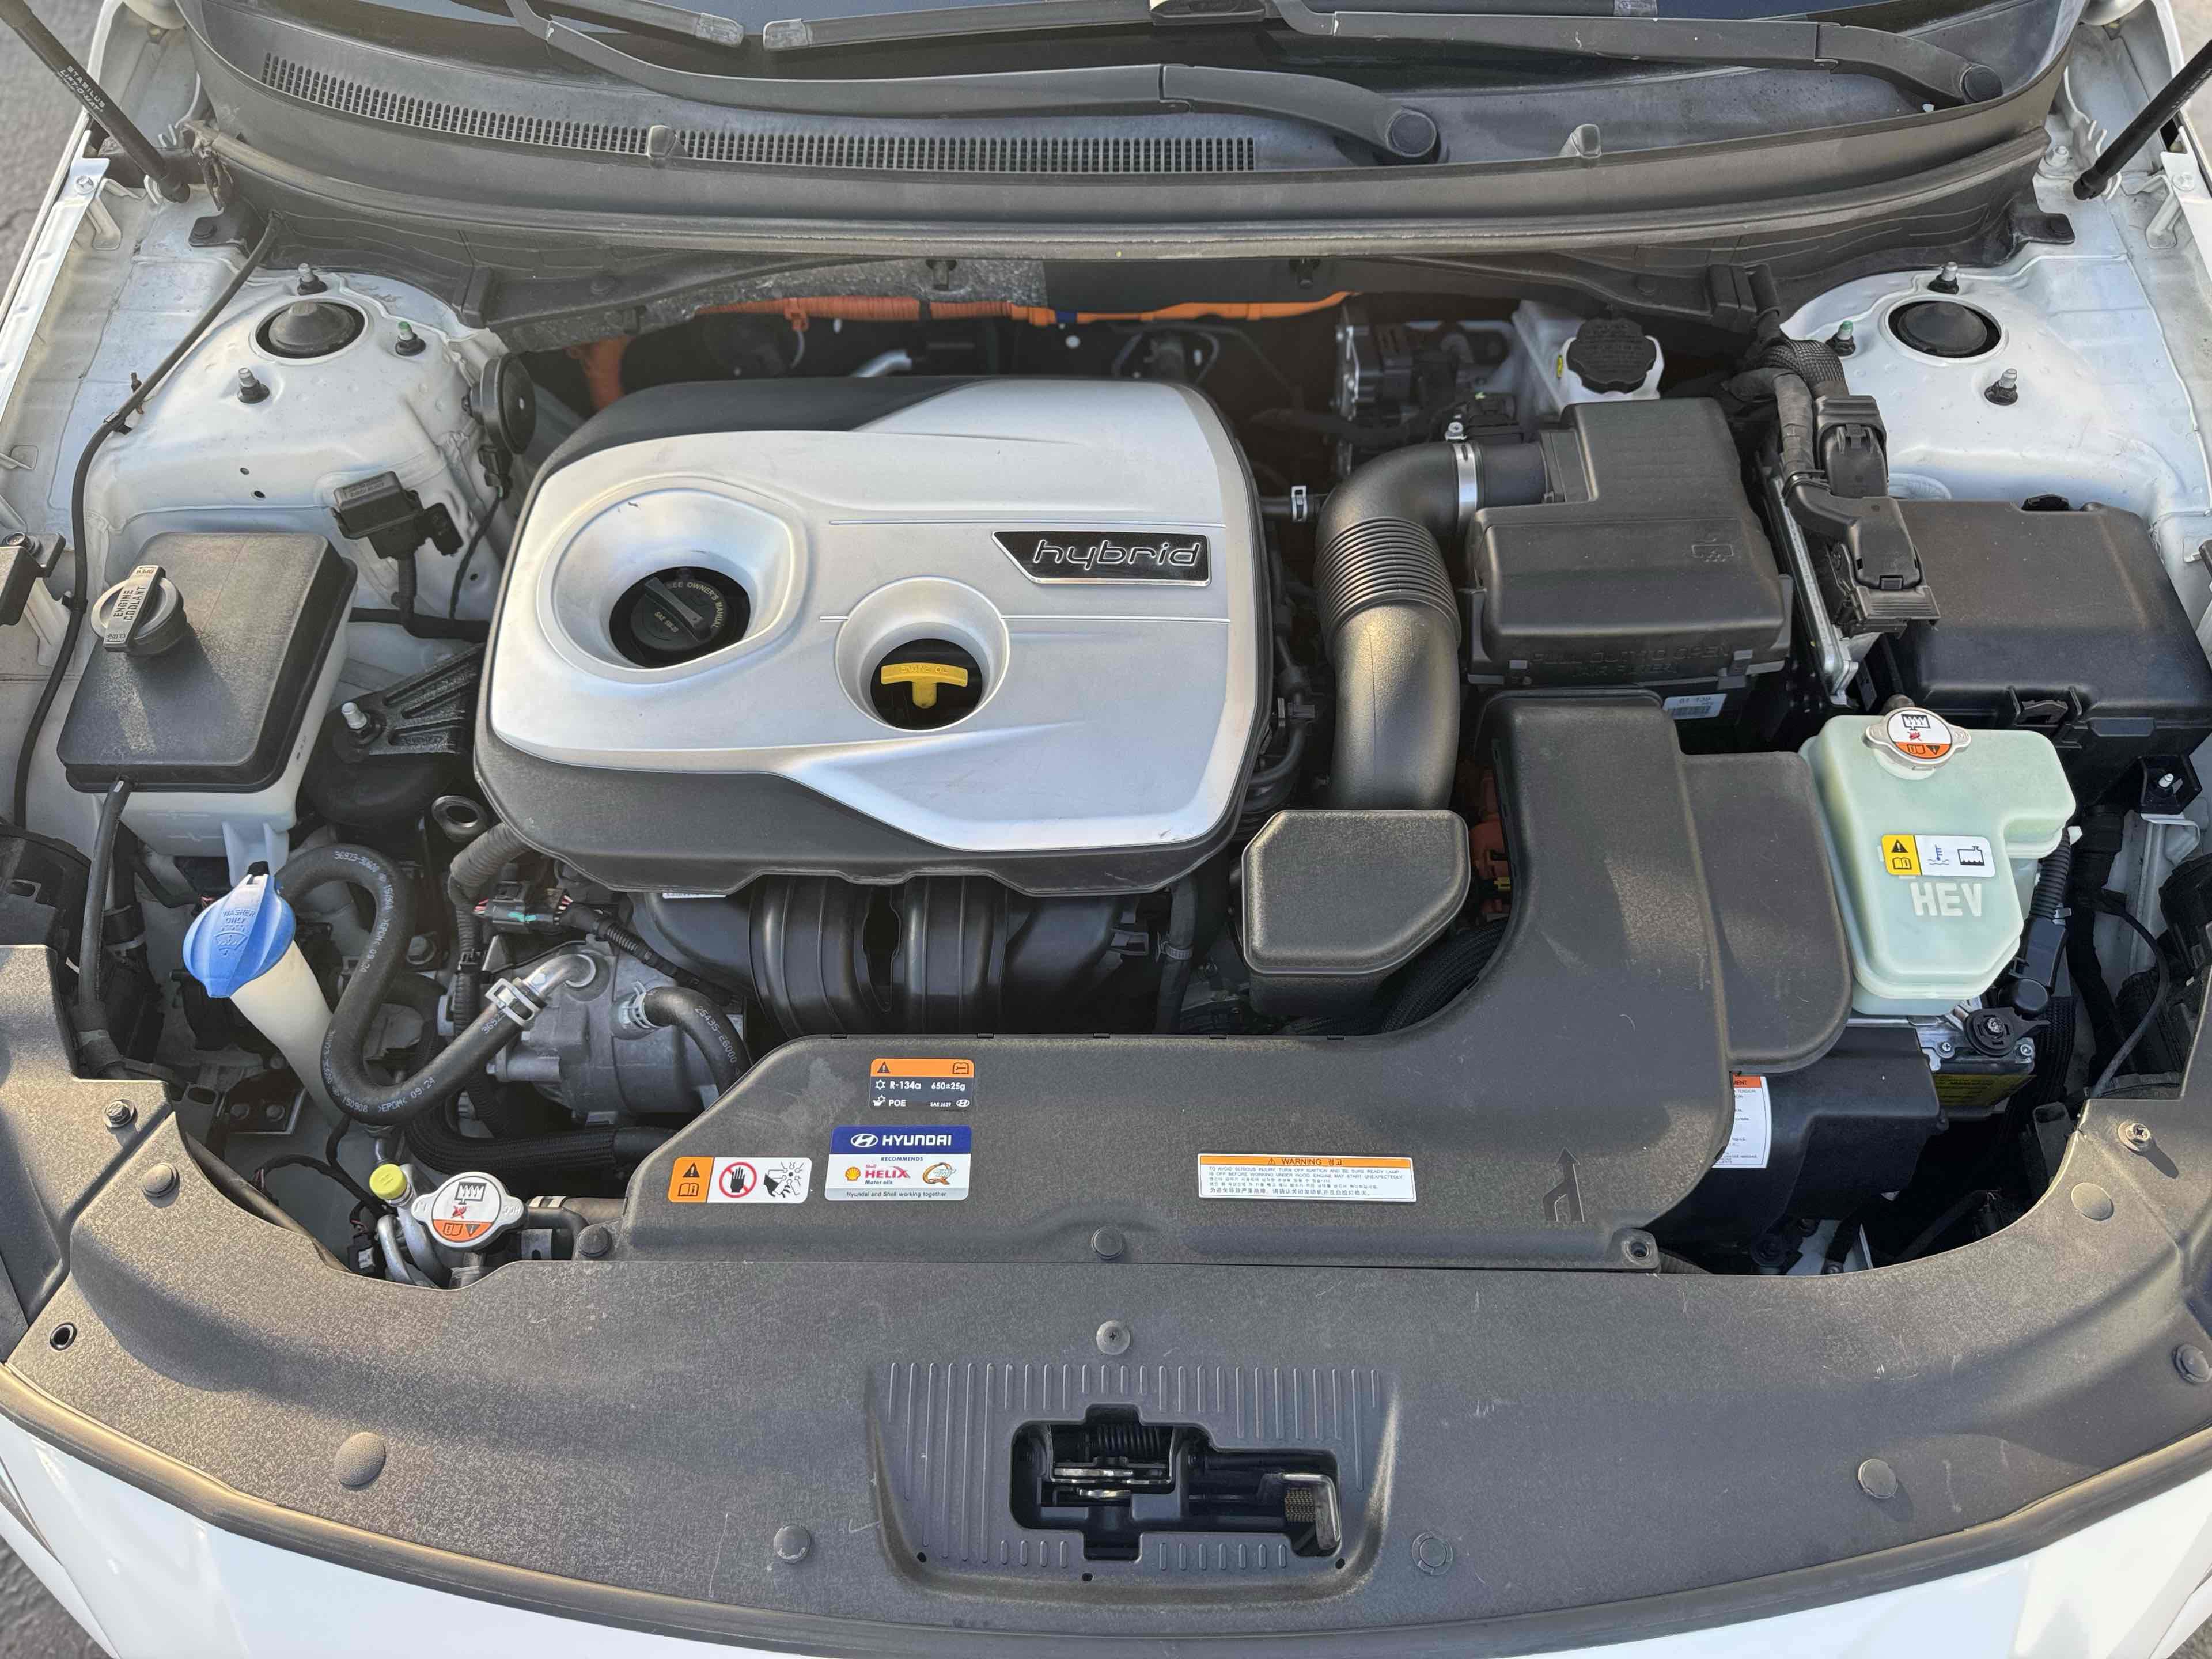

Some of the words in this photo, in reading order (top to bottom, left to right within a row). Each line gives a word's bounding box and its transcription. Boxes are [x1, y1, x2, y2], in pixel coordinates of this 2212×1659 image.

[66, 65, 106, 108] STABILUS
[1033, 539, 1200, 570] hybrid
[113, 590, 134, 618] ENGINE
[123, 586, 147, 621] COOLANT
[1910, 882, 1982, 917] HEV
[222, 908, 256, 917] WASHER
[694, 1006, 738, 1063] 25435-E6000
[889, 1081, 922, 1090] R-134a
[931, 1082, 966, 1091] 650±25g
[343, 1096, 369, 1112] 150908
[889, 1099, 907, 1107] POE
[882, 1134, 952, 1146] HYUNDAI
[864, 1166, 911, 1179] HELIX
